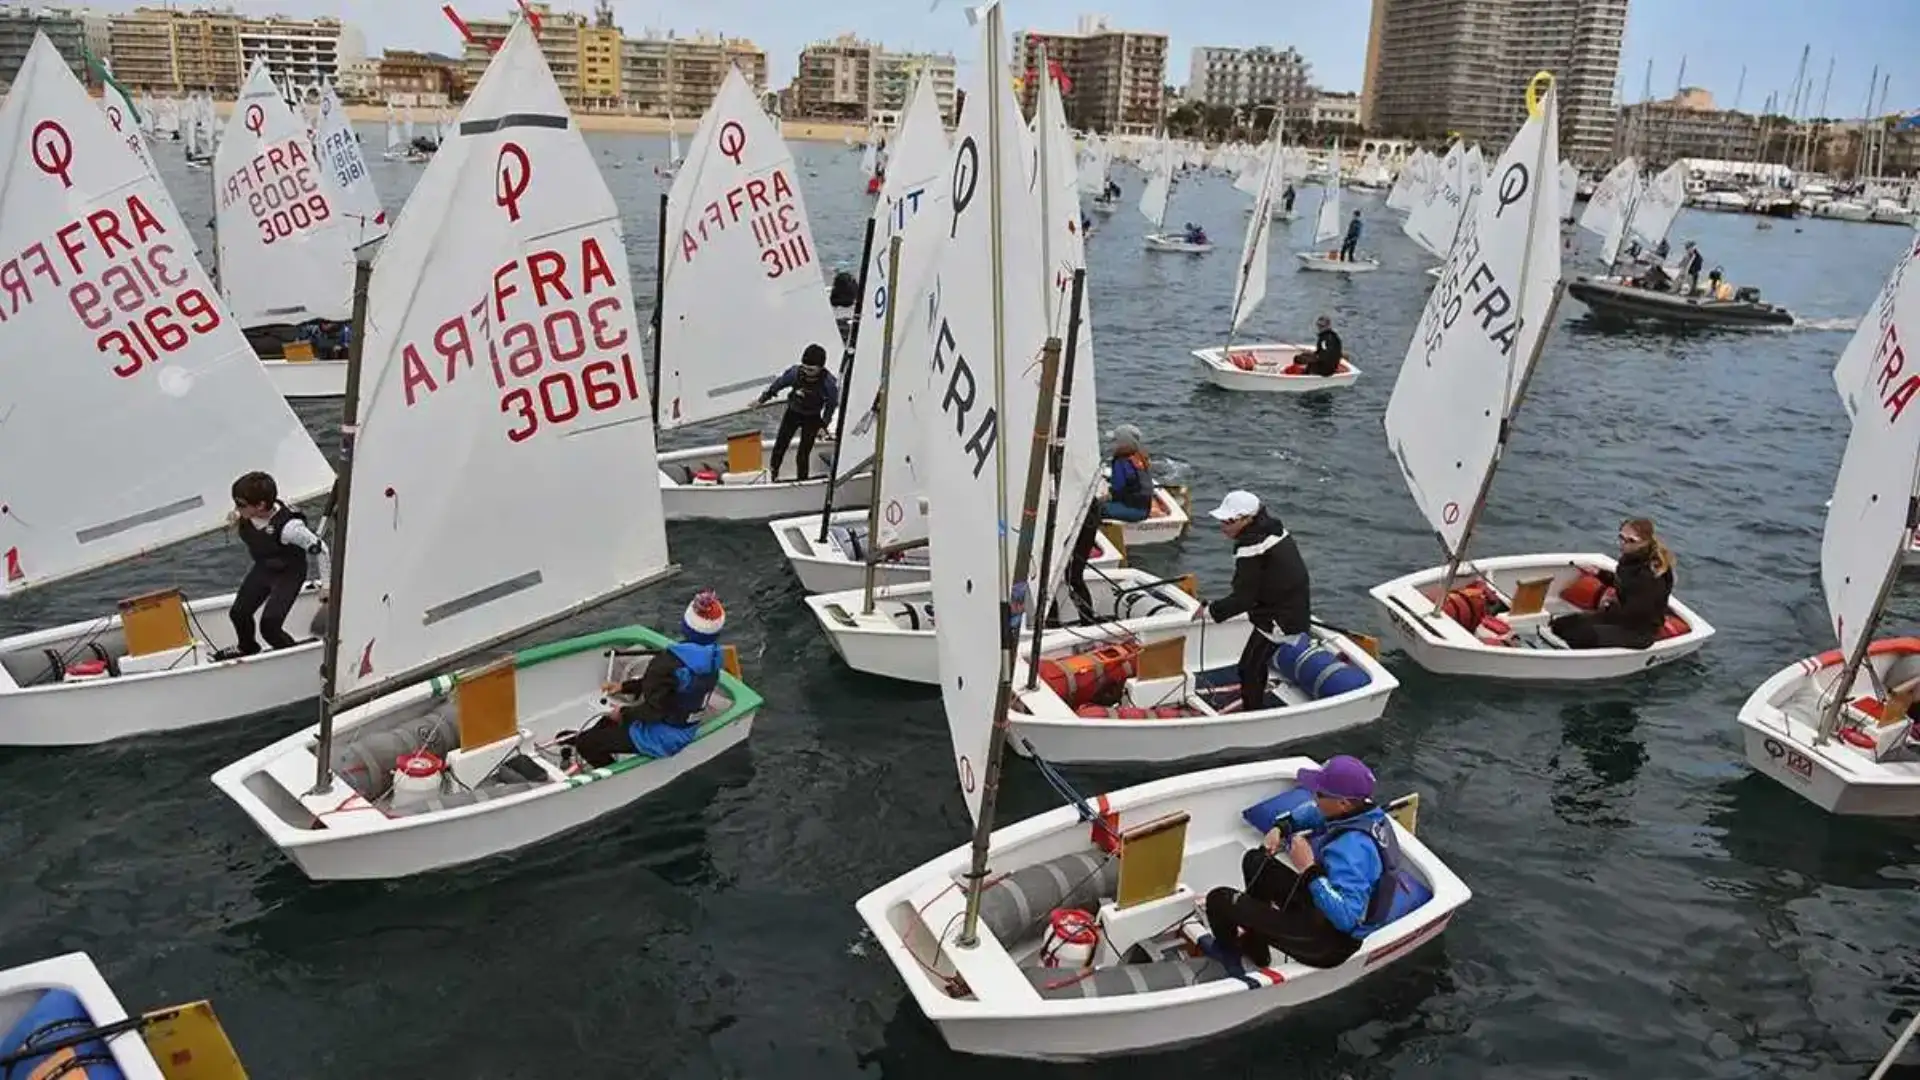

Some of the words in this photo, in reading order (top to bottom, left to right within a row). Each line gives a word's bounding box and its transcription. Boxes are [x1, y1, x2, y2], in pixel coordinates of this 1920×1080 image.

[253, 140, 307, 182] FRA
[325, 127, 352, 154] FRA
[338, 160, 365, 187] 3181
[57, 195, 166, 275] FRA
[258, 195, 329, 244] 3009
[726, 170, 793, 222] FRA
[493, 237, 616, 322] FRA
[761, 235, 810, 279] 3111
[98, 289, 220, 378] 3169
[1465, 262, 1524, 355] FRA
[501, 353, 639, 442] 3061
[932, 316, 997, 479] FRA
[1876, 324, 1920, 423] FRA
